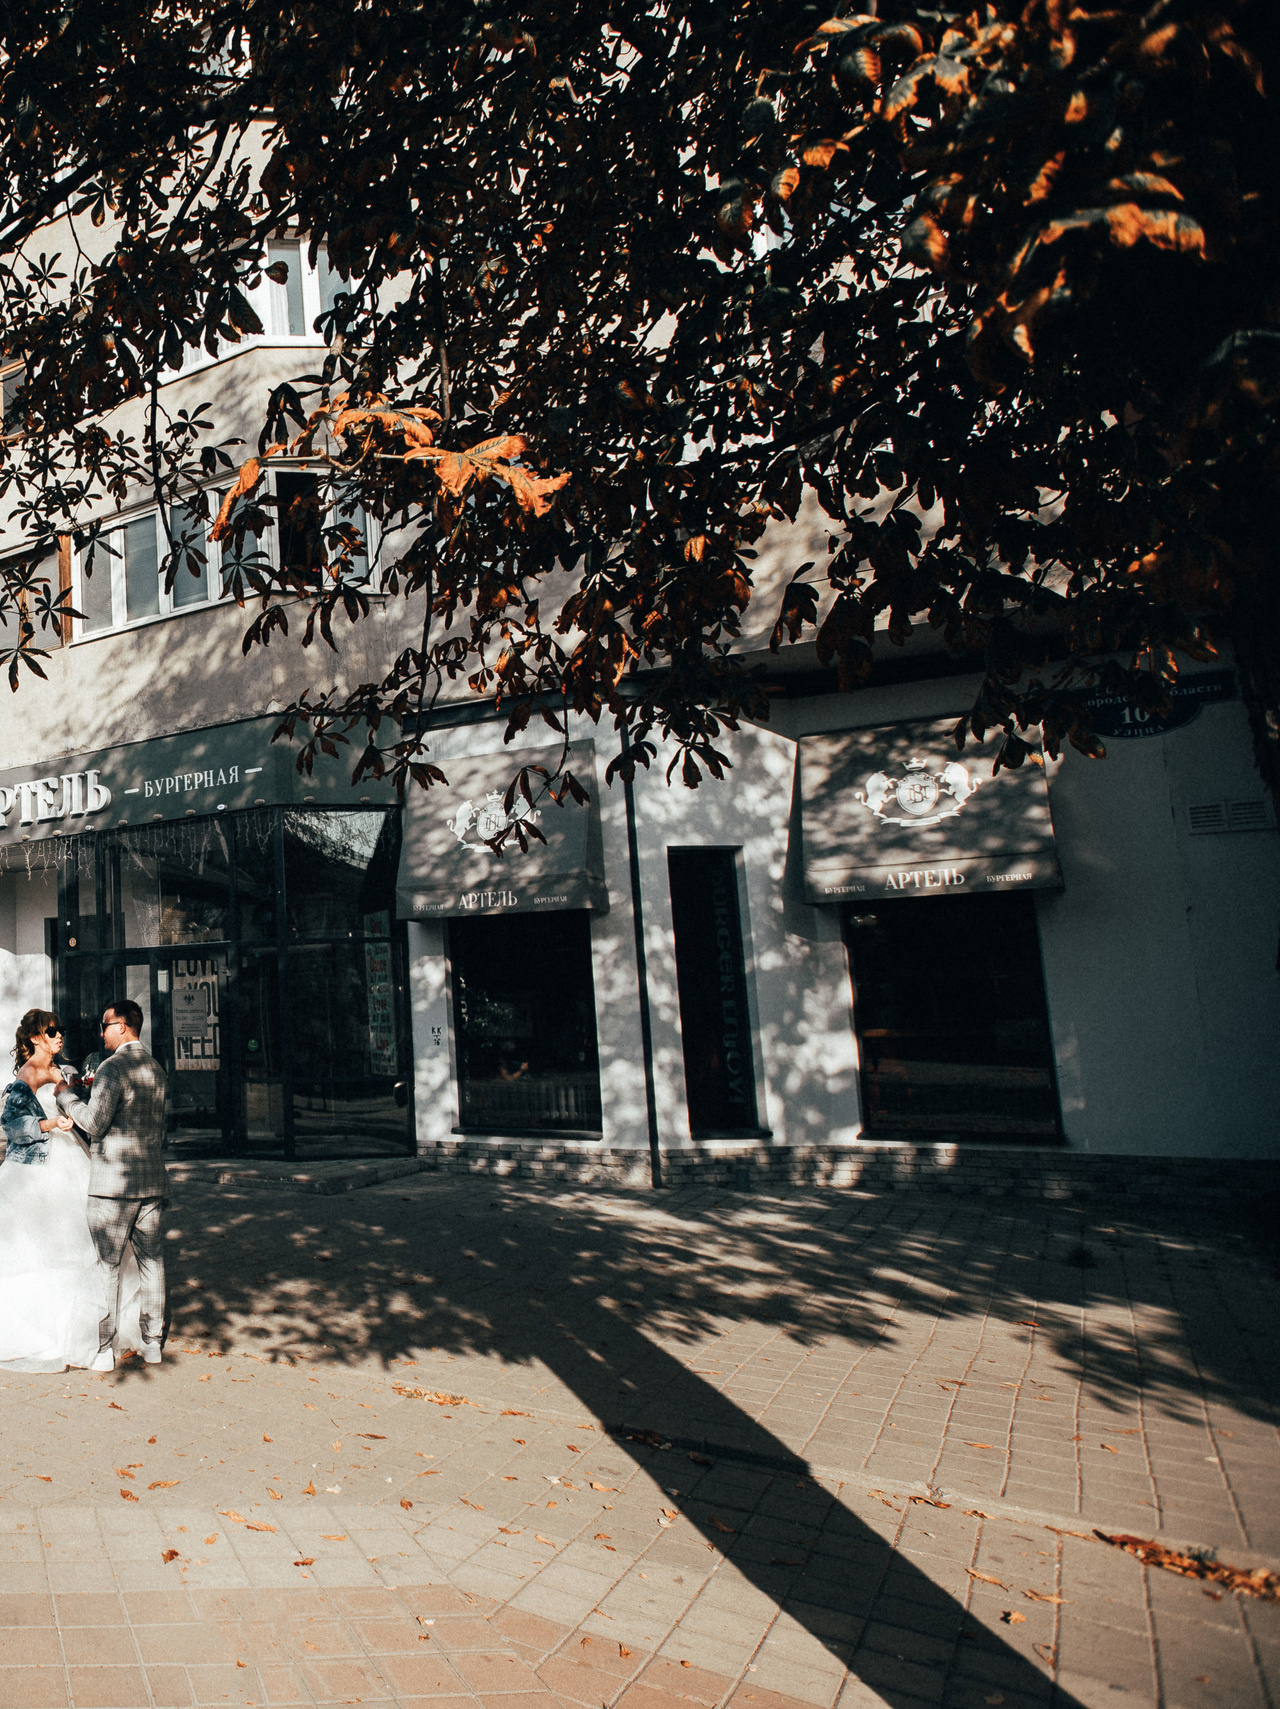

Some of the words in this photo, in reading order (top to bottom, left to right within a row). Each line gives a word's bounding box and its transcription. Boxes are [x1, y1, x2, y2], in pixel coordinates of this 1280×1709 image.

[1169, 684, 1222, 697] бласти
[144, 765, 240, 799] БУРГЕРНАЯ
[824, 885, 866, 895] БУРГЕРНАЯ
[885, 868, 966, 891] АРТЕЛЬ
[986, 872, 1032, 883] БУРГЕРНАЯ
[458, 890, 518, 910] АРТЕЛЬ
